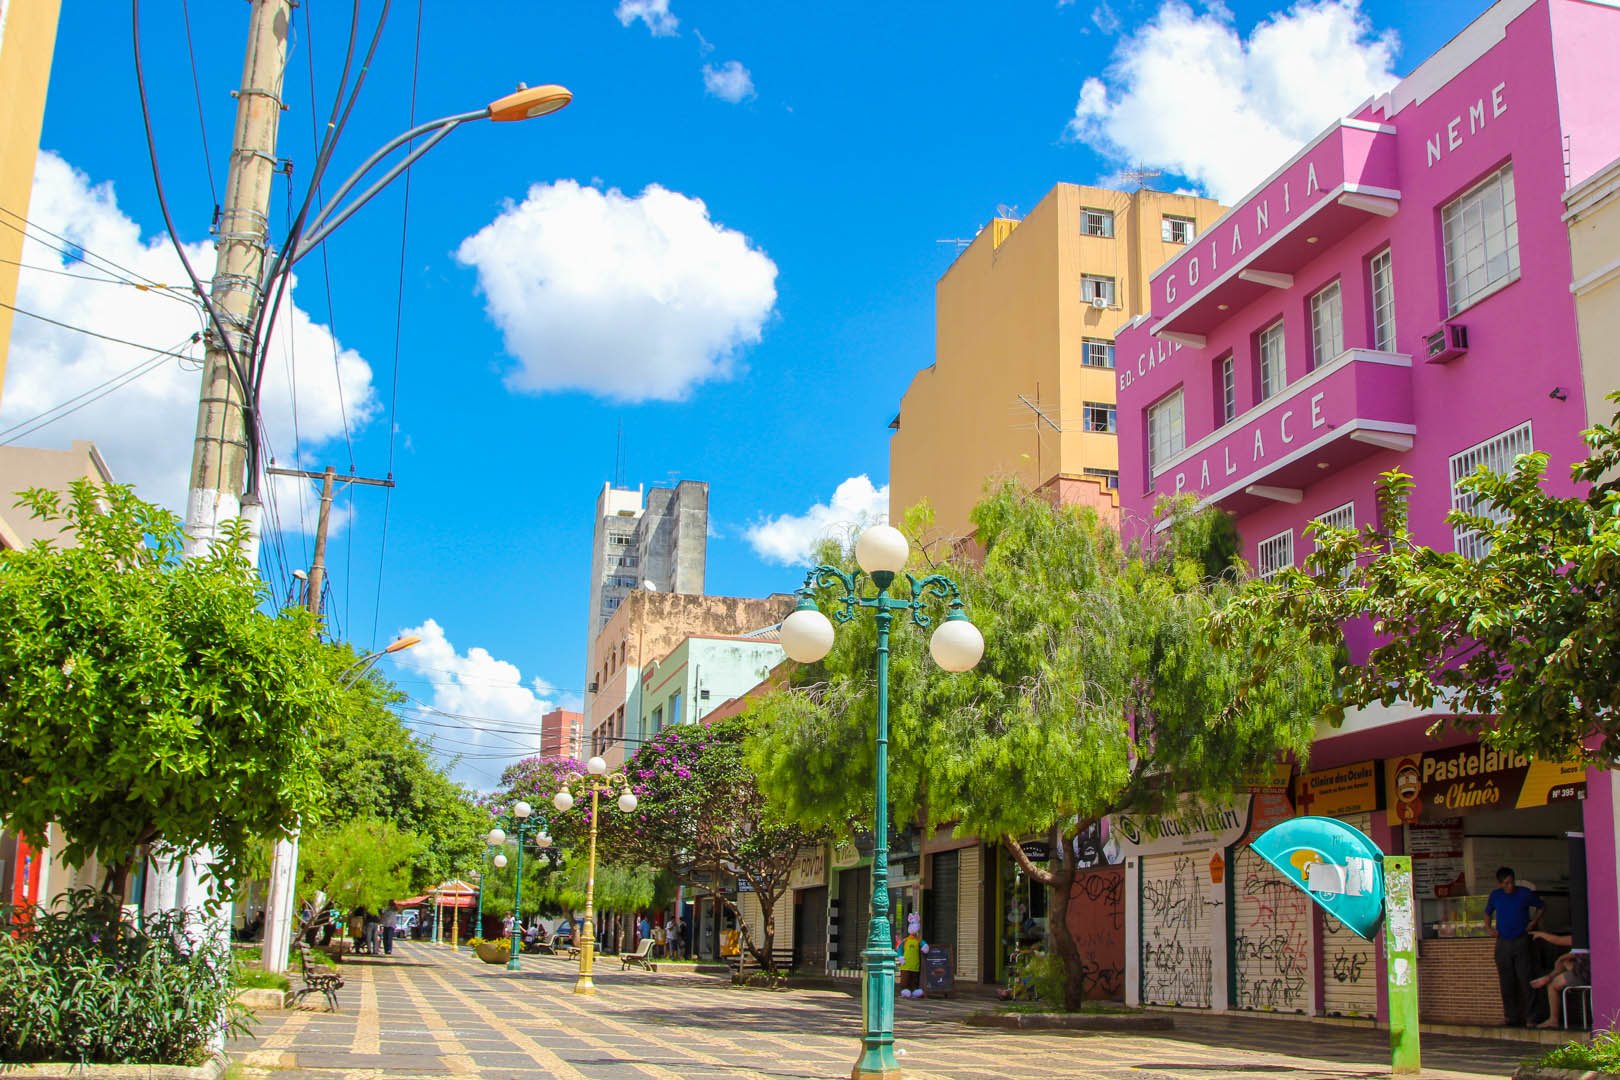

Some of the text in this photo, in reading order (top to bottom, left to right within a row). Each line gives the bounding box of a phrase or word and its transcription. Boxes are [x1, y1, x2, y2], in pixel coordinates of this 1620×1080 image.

[1425, 81, 1507, 168] NEME
[1165, 161, 1321, 305] GOIANIA
[1119, 369, 1135, 392] ED.
[1175, 391, 1326, 499] PALACE
[1422, 742, 1529, 784] Pastelaria
[1433, 779, 1500, 809] do Chinês
[1561, 787, 1575, 798] 395
